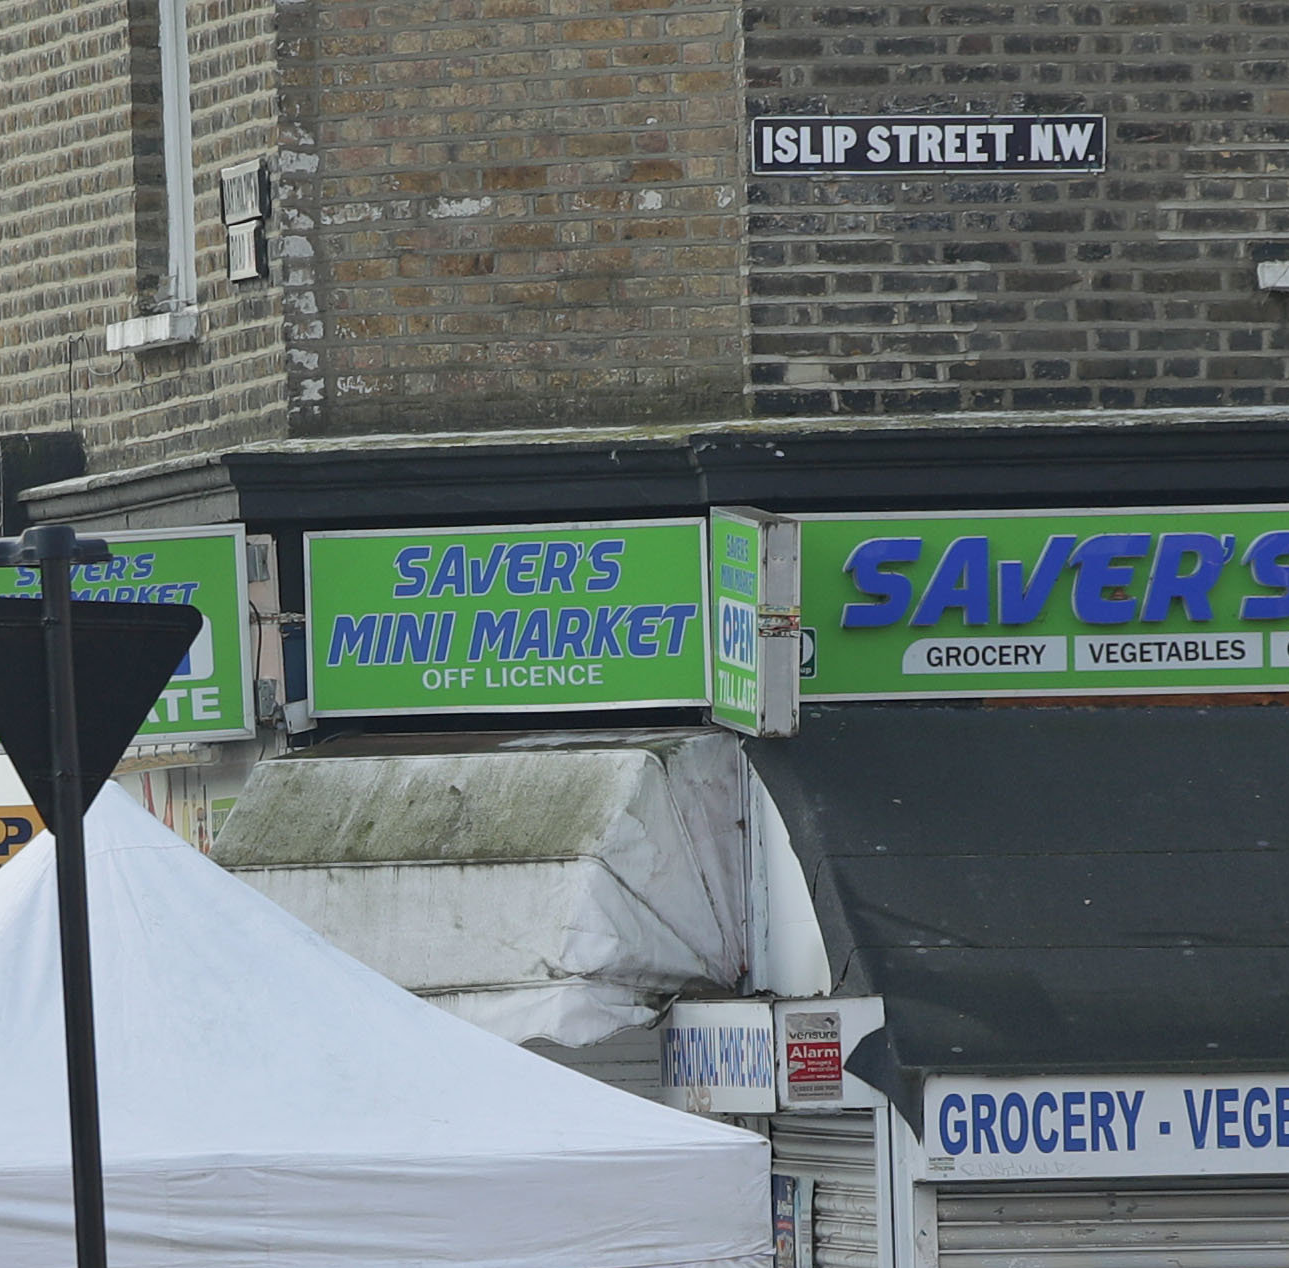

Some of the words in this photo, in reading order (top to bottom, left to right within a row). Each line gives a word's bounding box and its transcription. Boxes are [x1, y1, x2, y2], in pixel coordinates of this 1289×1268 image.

[762, 125, 857, 164] ISLIP
[391, 539, 624, 598] SAVER'S
[327, 609, 455, 667] MINI
[467, 603, 698, 663] MARKET
[723, 603, 753, 666] OPEN
[925, 643, 1046, 668] GROCERY
[1088, 639, 1246, 664] VEGETABLES
[421, 665, 480, 689] OFF
[485, 663, 604, 688] LICENCE
[718, 668, 736, 708] TILL
[737, 675, 756, 714] LATE
[720, 1026, 746, 1088] PHONE
[747, 1026, 772, 1089] CARDS
[789, 1045, 839, 1059] Alarm
[939, 1089, 1146, 1156] GROCERY
